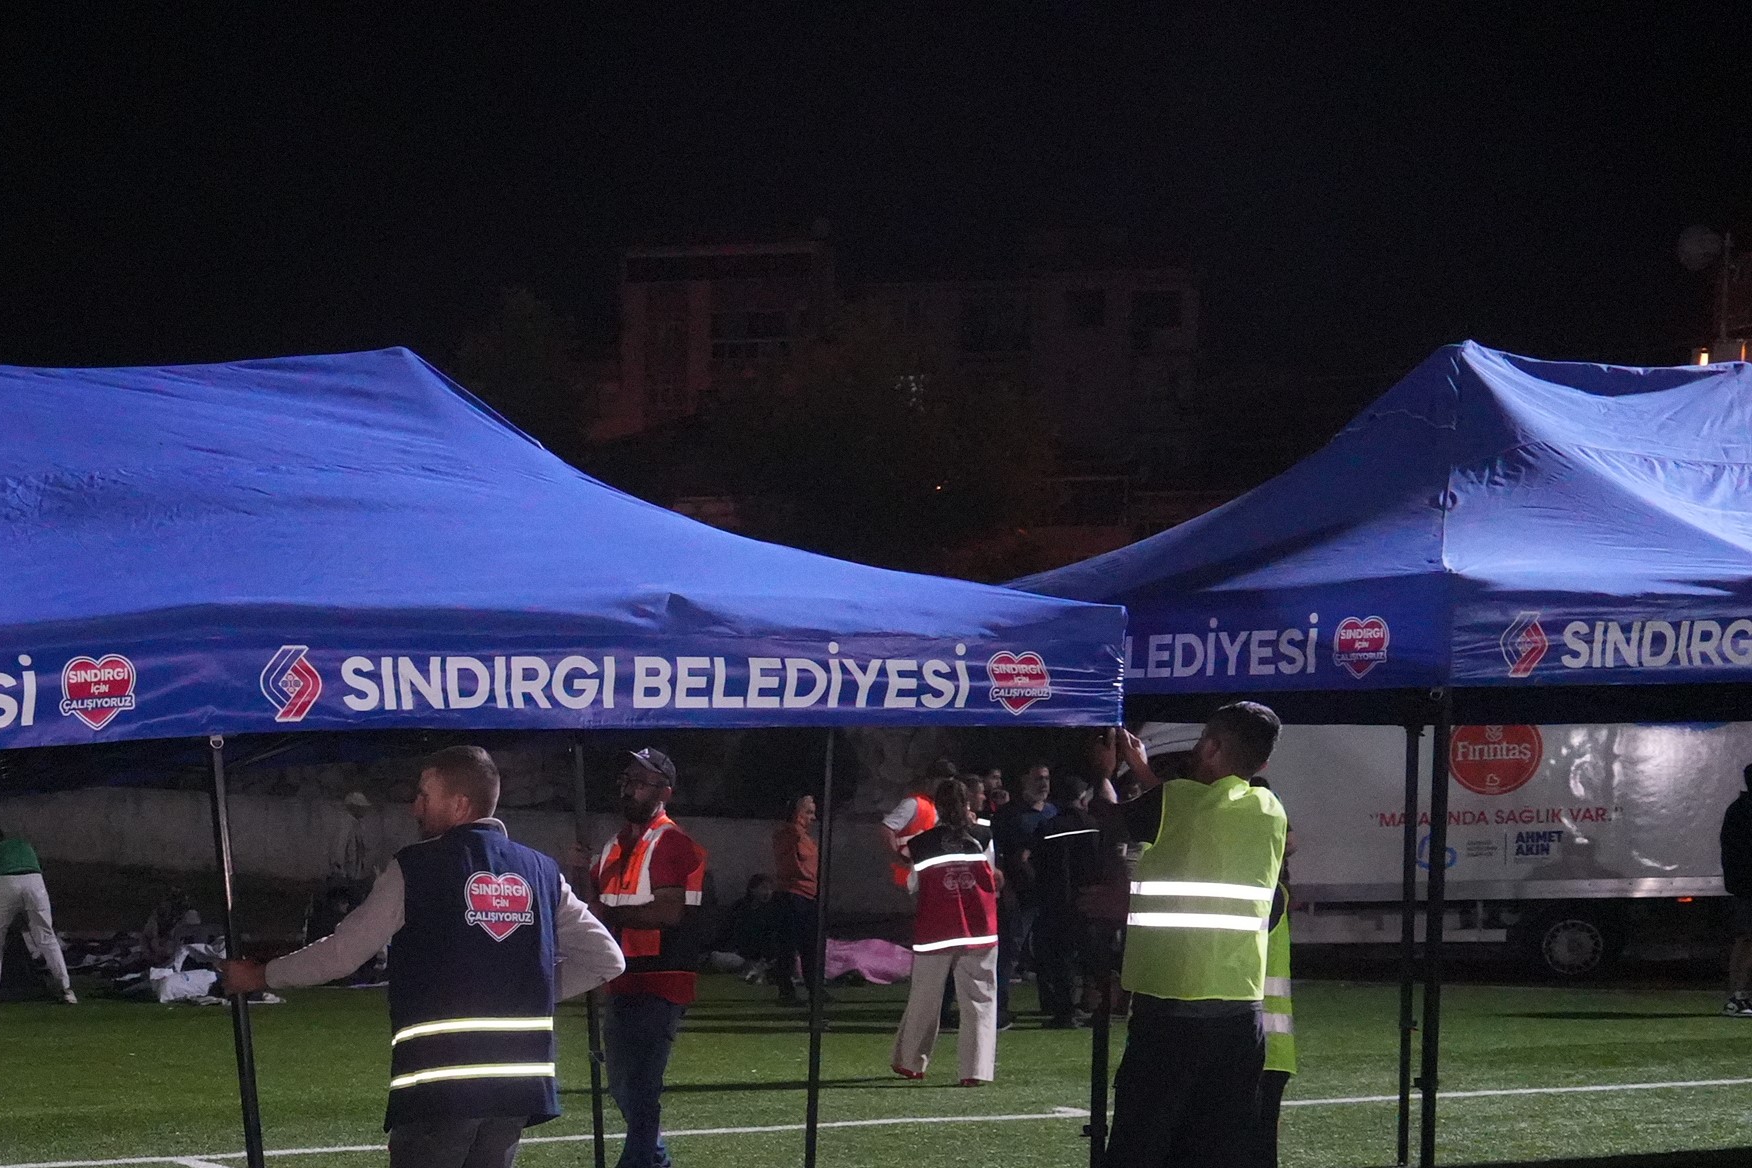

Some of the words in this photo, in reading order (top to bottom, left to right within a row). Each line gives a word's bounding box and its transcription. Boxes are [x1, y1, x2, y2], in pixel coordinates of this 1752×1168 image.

[1123, 612, 1319, 679] LEDİYESİ
[1561, 618, 1752, 668] SINDIRG
[69, 668, 129, 684] SINDIRGI
[341, 655, 615, 711] SINDIRGI
[633, 642, 970, 709] BELEDİYESİ
[992, 664, 1042, 675] SINDIRGI
[91, 682, 109, 696] İÇİN
[63, 697, 132, 713] ÇALIŞIYORUZ
[1455, 740, 1532, 763] Fırıntaş
[1494, 805, 1564, 825] SAĞLIK
[1515, 830, 1564, 843] AHMET
[1515, 844, 1551, 856] AKIN
[471, 883, 526, 896] SINDIRGI
[467, 911, 531, 923] ÇALIŞIYORUZ
